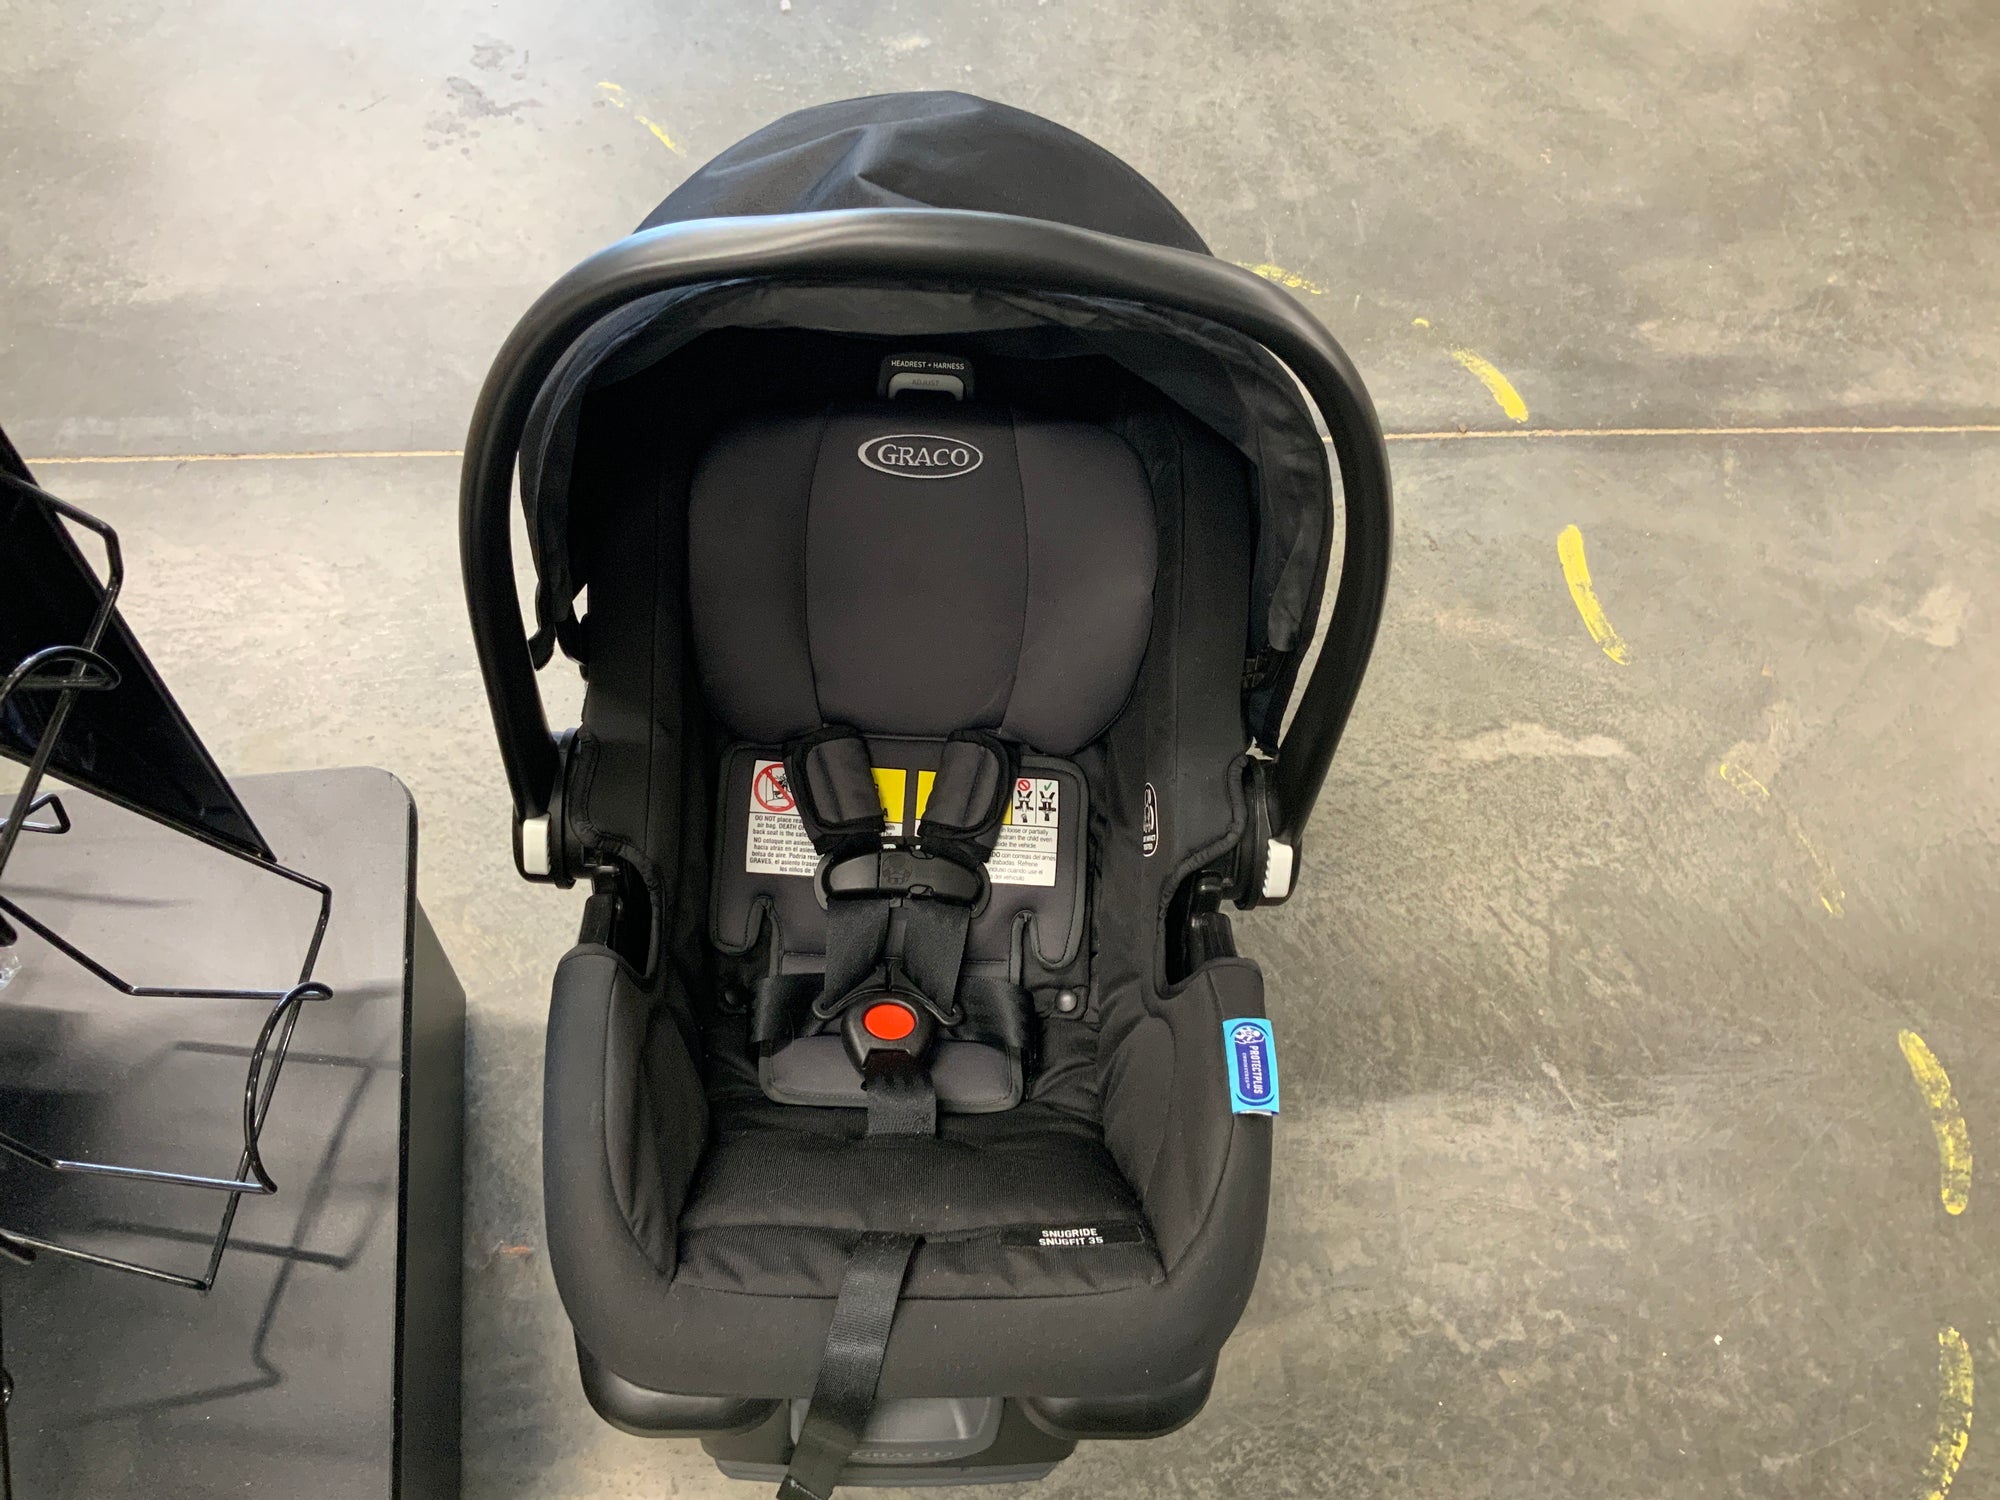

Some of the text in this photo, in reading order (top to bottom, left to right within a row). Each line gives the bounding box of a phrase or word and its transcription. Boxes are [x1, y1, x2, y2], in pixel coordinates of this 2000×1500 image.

[891, 360, 927, 368] HEADREST
[933, 362, 965, 370] HARNESS
[877, 443, 970, 467] GRACO
[1249, 1045, 1263, 1094] PROTECTPLUS
[1041, 1228, 1098, 1238] SNUGRIDE
[1038, 1236, 1104, 1246] SNUGFIT 35
